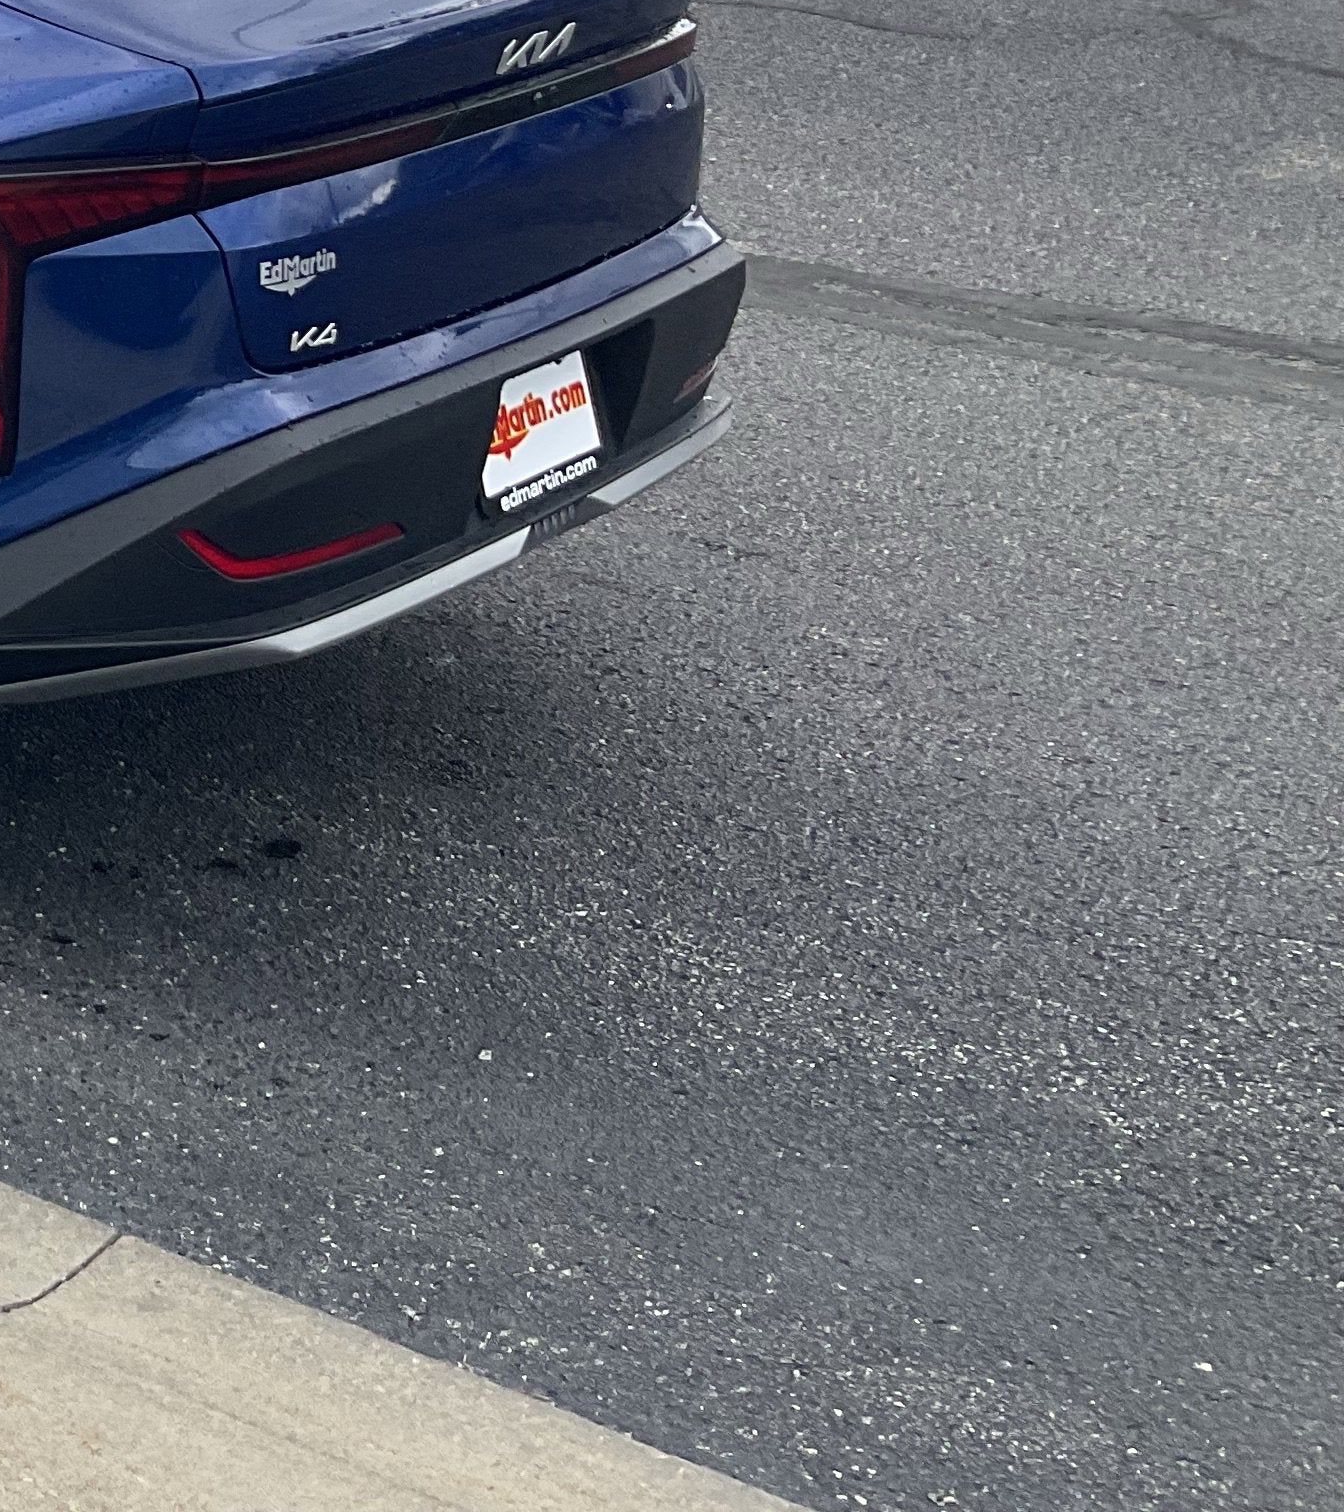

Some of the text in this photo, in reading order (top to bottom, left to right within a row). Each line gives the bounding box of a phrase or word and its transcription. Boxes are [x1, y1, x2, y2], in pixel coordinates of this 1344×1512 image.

[495, 21, 577, 76] KIA
[259, 248, 337, 288] EdMartin
[290, 322, 338, 352] K4
[493, 380, 587, 443] Martin.com
[499, 454, 598, 512] edmartin.com
